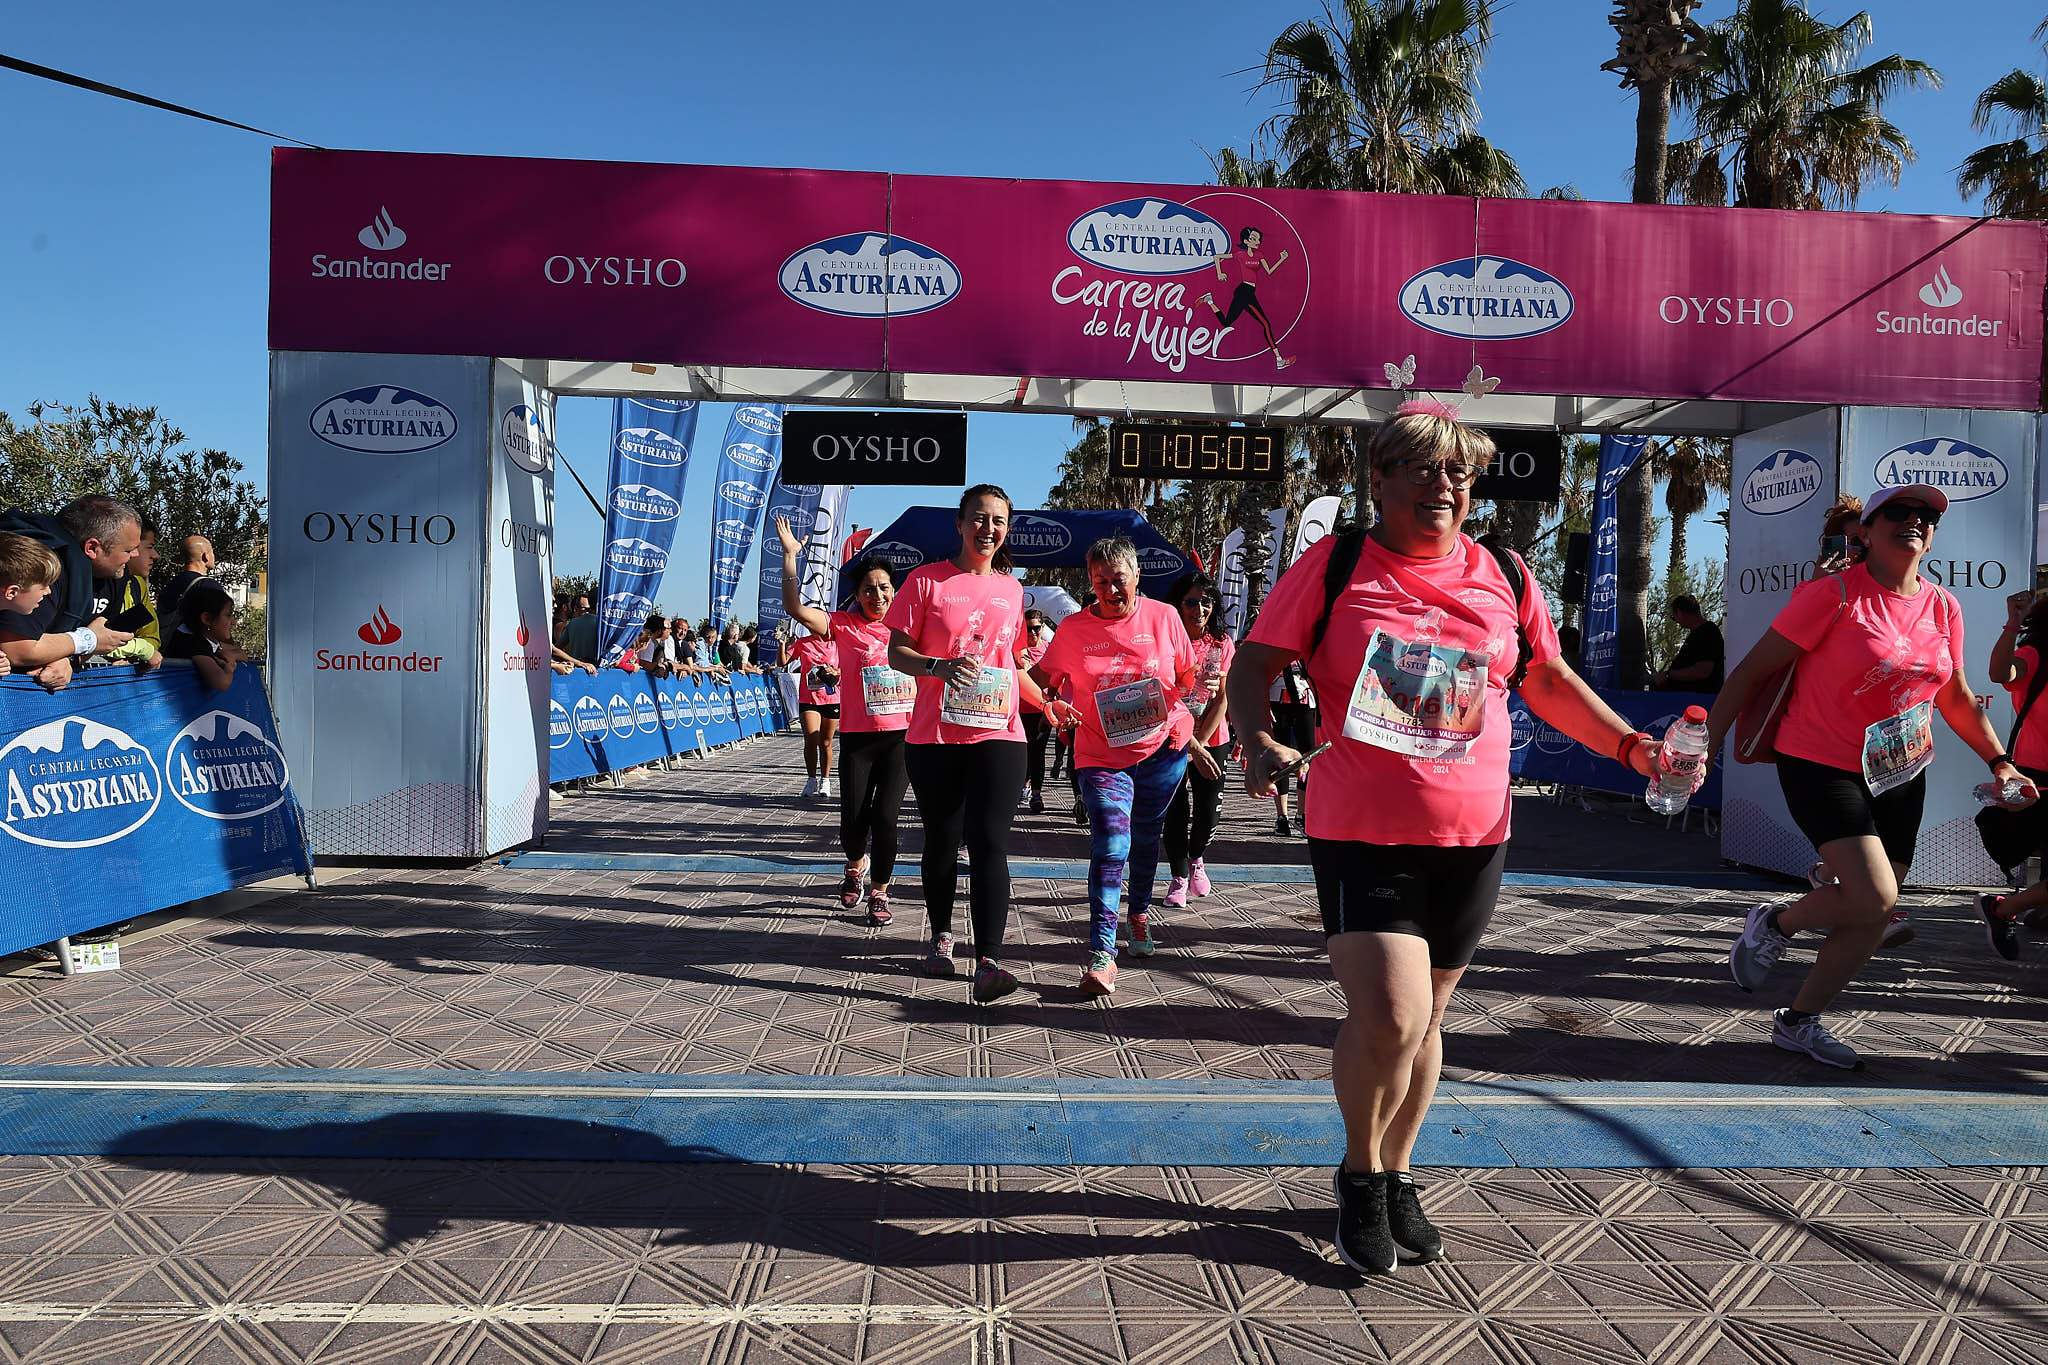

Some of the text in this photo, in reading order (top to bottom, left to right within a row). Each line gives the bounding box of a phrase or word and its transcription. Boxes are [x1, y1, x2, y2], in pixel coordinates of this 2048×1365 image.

[1079, 223, 1217, 257] ASTURIANA
[1105, 222, 1214, 235] CENTRAL LECHERA
[311, 254, 451, 281] Santander
[543, 255, 688, 288] OYSHO
[792, 261, 948, 296] ASTURIANA
[821, 260, 879, 270] CENTRAL
[1051, 265, 1186, 311] Carrera
[1411, 284, 1560, 319] ASTURIANA
[1439, 283, 1555, 295] CENTRAL LECHERA
[1659, 295, 1795, 328] OYSHO
[1875, 311, 2003, 337] Santander
[1083, 308, 1235, 373] de la Mujer
[320, 409, 447, 438] ASTURIANA
[343, 408, 443, 418] CENTRAL LECHERA
[619, 435, 682, 462] ASTURIANA
[729, 447, 773, 469] ASTURIANA
[812, 434, 941, 463] OYSHO
[1121, 432, 1272, 471] 01:05:03
[1757, 465, 1814, 483] CENTRAL LECHERA
[1883, 460, 1998, 487] ASTURIANA
[1904, 459, 1995, 468] CENTRAL LECHERA
[1746, 474, 1816, 504] ASTURIANA
[613, 491, 674, 517] ASTURIANA
[303, 511, 456, 546] OYSHO
[501, 518, 548, 558] OYSHO
[1740, 560, 1817, 595] OYSHO
[1919, 559, 2007, 590] SHO
[316, 649, 443, 672] Santander
[1082, 641, 1110, 653] OYSHO
[503, 651, 541, 671] Santander
[1355, 710, 1386, 727] CARRERA
[1386, 720, 1396, 729] DE
[1396, 723, 1406, 733] LA
[1407, 725, 1433, 737] MUJER
[1438, 731, 1474, 740] VALENCIA
[1359, 725, 1399, 745] OYSHO
[1400, 716, 1424, 727] 1782
[29, 754, 143, 777] CENTRAL LECHERA
[193, 748, 233, 760] CENTRAL
[5, 768, 155, 822] ASTURIANA
